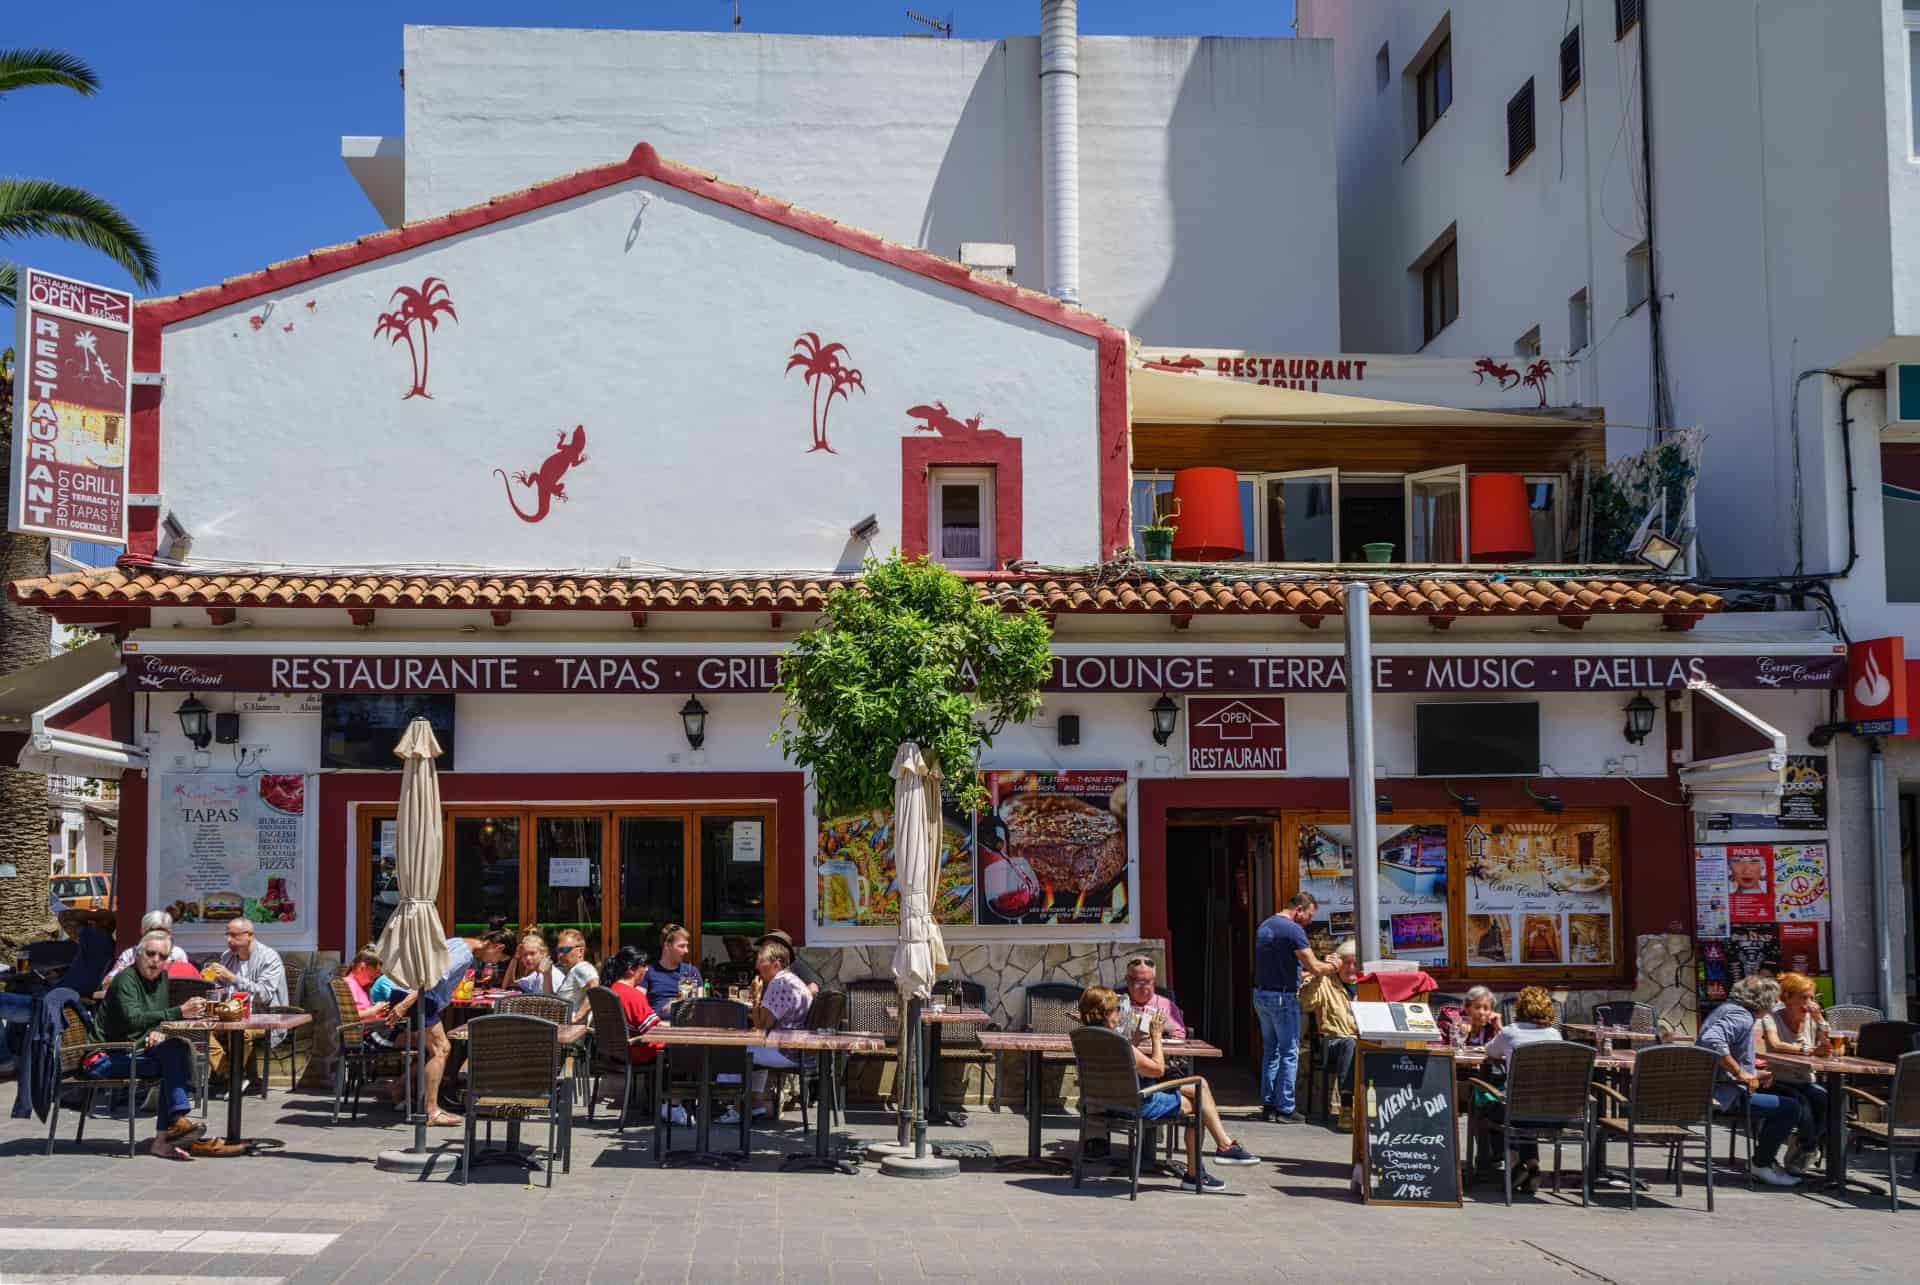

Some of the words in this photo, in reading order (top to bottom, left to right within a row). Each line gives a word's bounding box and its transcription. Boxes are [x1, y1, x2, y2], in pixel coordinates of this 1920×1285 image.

[32, 284, 85, 313] OPEN
[1217, 357, 1367, 380] RESTAURANT
[29, 317, 59, 524] RESTAURANT
[72, 473, 120, 497] GRILL
[56, 470, 70, 528] LOUNGE
[70, 504, 108, 521] TAPAS
[271, 658, 518, 690] RESTAURANTE
[555, 658, 660, 690] TAPAS
[1062, 657, 1214, 689] LOUNGE
[1248, 657, 1393, 688] TERRAE
[1425, 658, 1535, 689] MUSIC
[1574, 657, 1707, 688] PAELLAS
[1221, 711, 1252, 724] OPEN
[1192, 747, 1283, 769] RESTAURANT
[183, 808, 239, 823] TAPAS
[1733, 848, 1760, 856] PACHA
